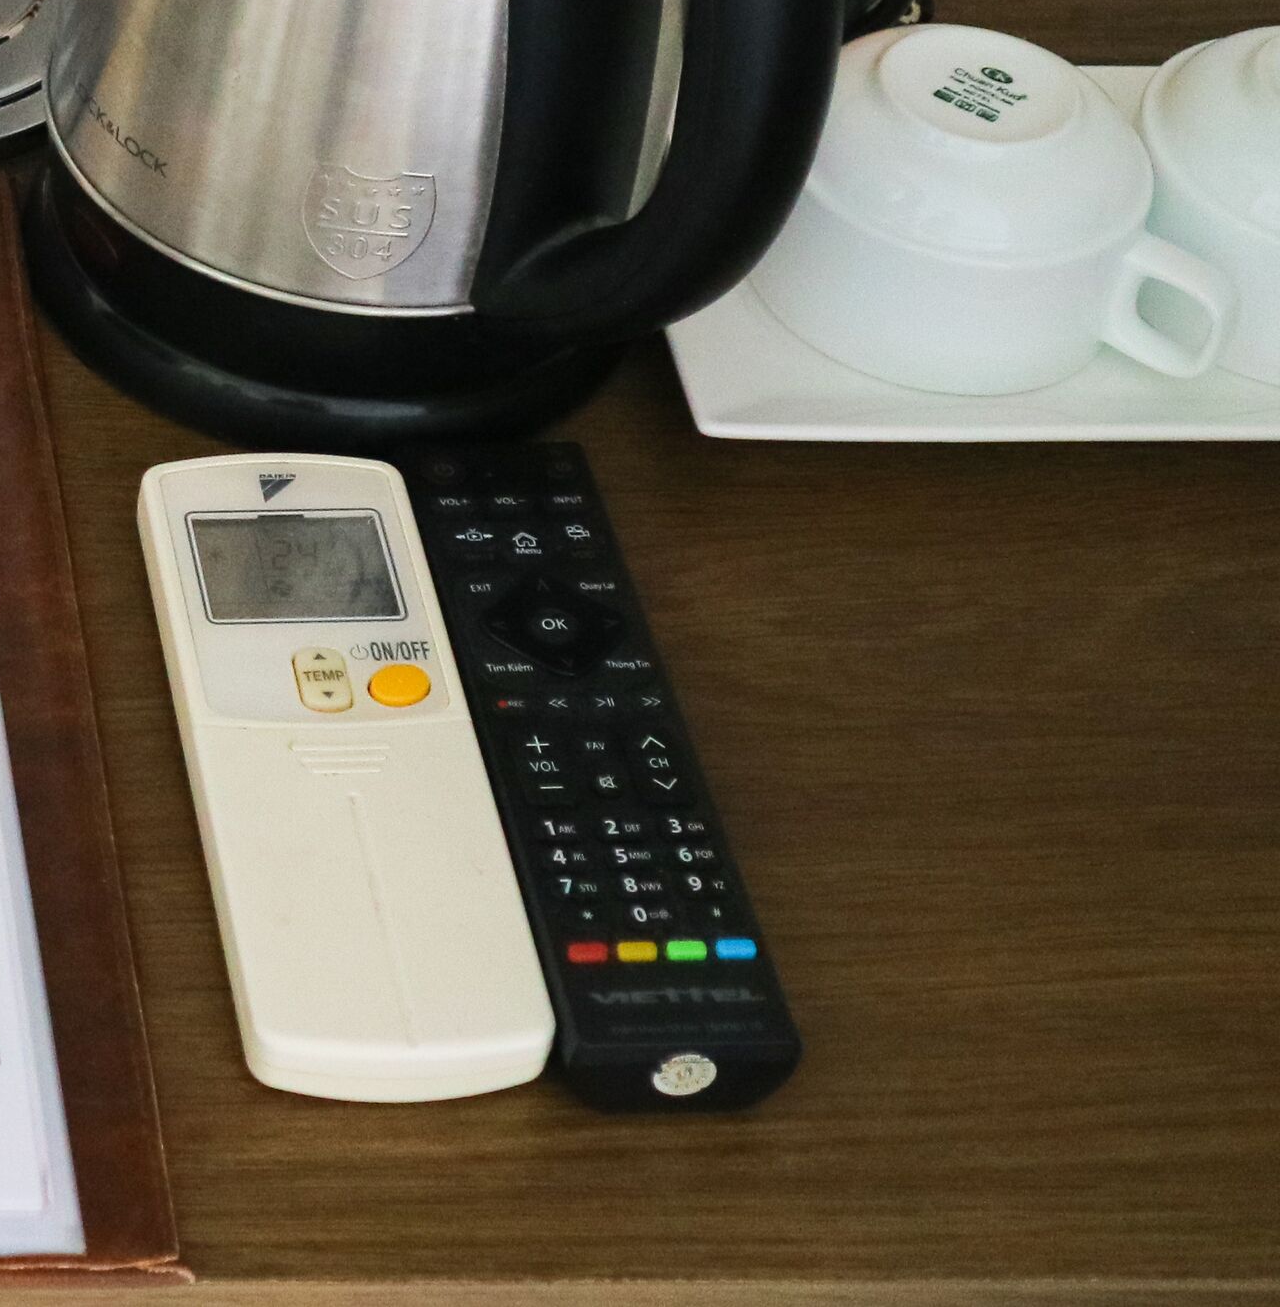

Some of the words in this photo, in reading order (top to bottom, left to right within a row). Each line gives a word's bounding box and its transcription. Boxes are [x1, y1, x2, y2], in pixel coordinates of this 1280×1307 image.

[469, 583, 492, 593] EXIT
[541, 618, 569, 632] OK
[369, 641, 431, 662] ON/OFF
[302, 670, 346, 683] TEMP
[529, 760, 560, 773] VOL
[648, 756, 671, 770] CH
[543, 819, 557, 837] 1
[603, 819, 620, 836] 2
[668, 818, 683, 835] 3
[551, 848, 568, 865] 4
[614, 848, 629, 864] 5
[678, 847, 694, 863] 6
[558, 877, 574, 895] 7
[622, 877, 639, 894] 8
[687, 875, 703, 892] 9
[632, 906, 648, 923] 0
